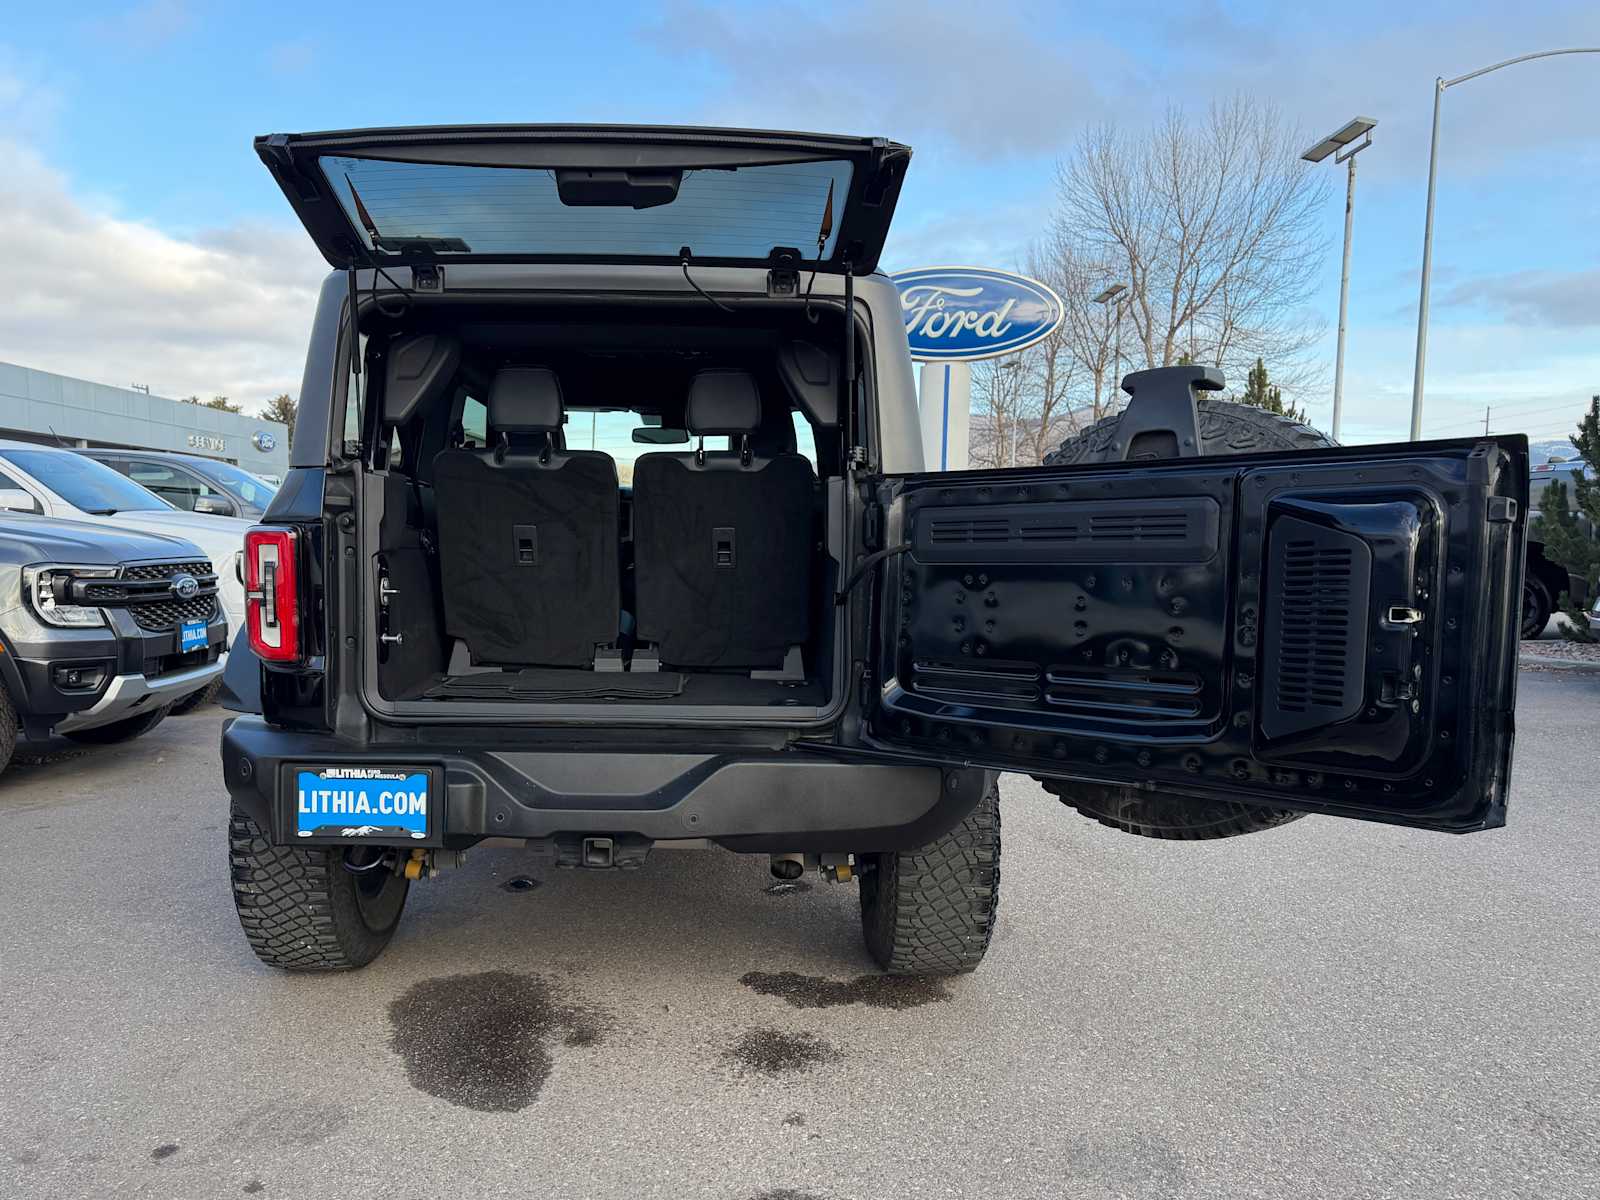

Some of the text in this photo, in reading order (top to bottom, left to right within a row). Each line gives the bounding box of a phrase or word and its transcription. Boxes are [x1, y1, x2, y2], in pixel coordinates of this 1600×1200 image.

[899, 285, 1017, 339] Ford
[335, 768, 367, 779] LITHIA
[299, 790, 426, 815] LITHIA.COM
